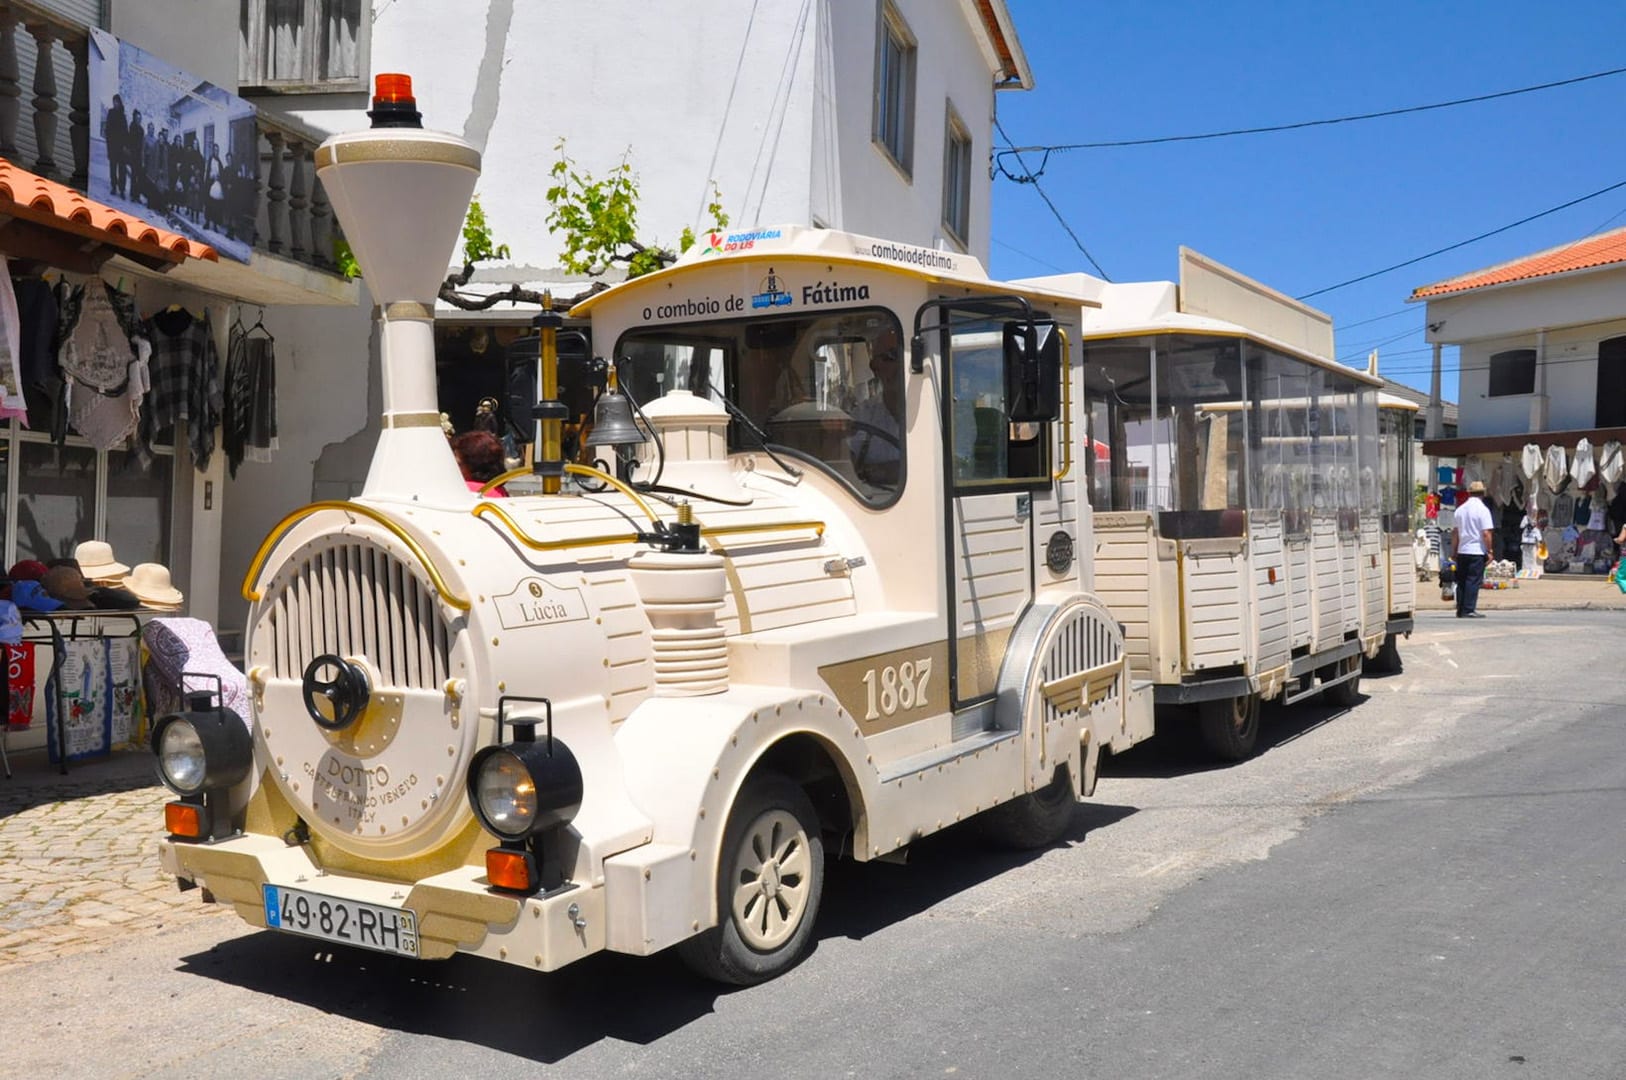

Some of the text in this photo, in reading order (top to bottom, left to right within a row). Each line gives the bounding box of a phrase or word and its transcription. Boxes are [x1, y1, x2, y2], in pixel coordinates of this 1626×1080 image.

[724, 240, 754, 251] DO LIS
[642, 281, 870, 320] o comboio de Fátima
[520, 599, 568, 622] Lúcia
[862, 657, 932, 721] 1887
[328, 757, 389, 791] DOTTO
[403, 938, 415, 952] 03
